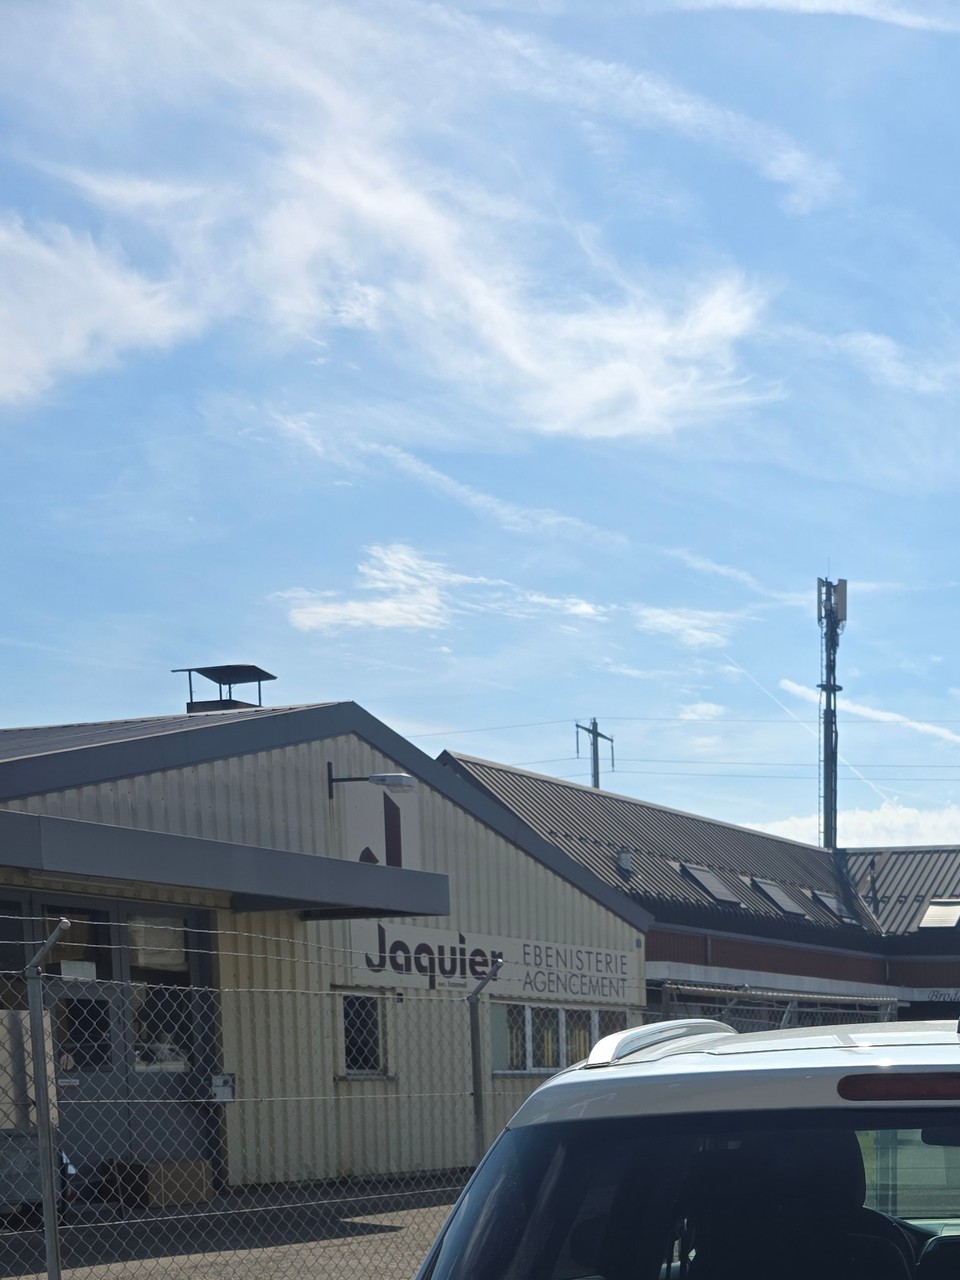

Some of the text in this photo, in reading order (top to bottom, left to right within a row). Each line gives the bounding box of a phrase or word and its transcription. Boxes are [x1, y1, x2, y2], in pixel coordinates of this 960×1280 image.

[365, 921, 503, 990] Jaquier
[522, 943, 628, 975] EBENISTERIE
[522, 970, 627, 999] AGENCEMENT
